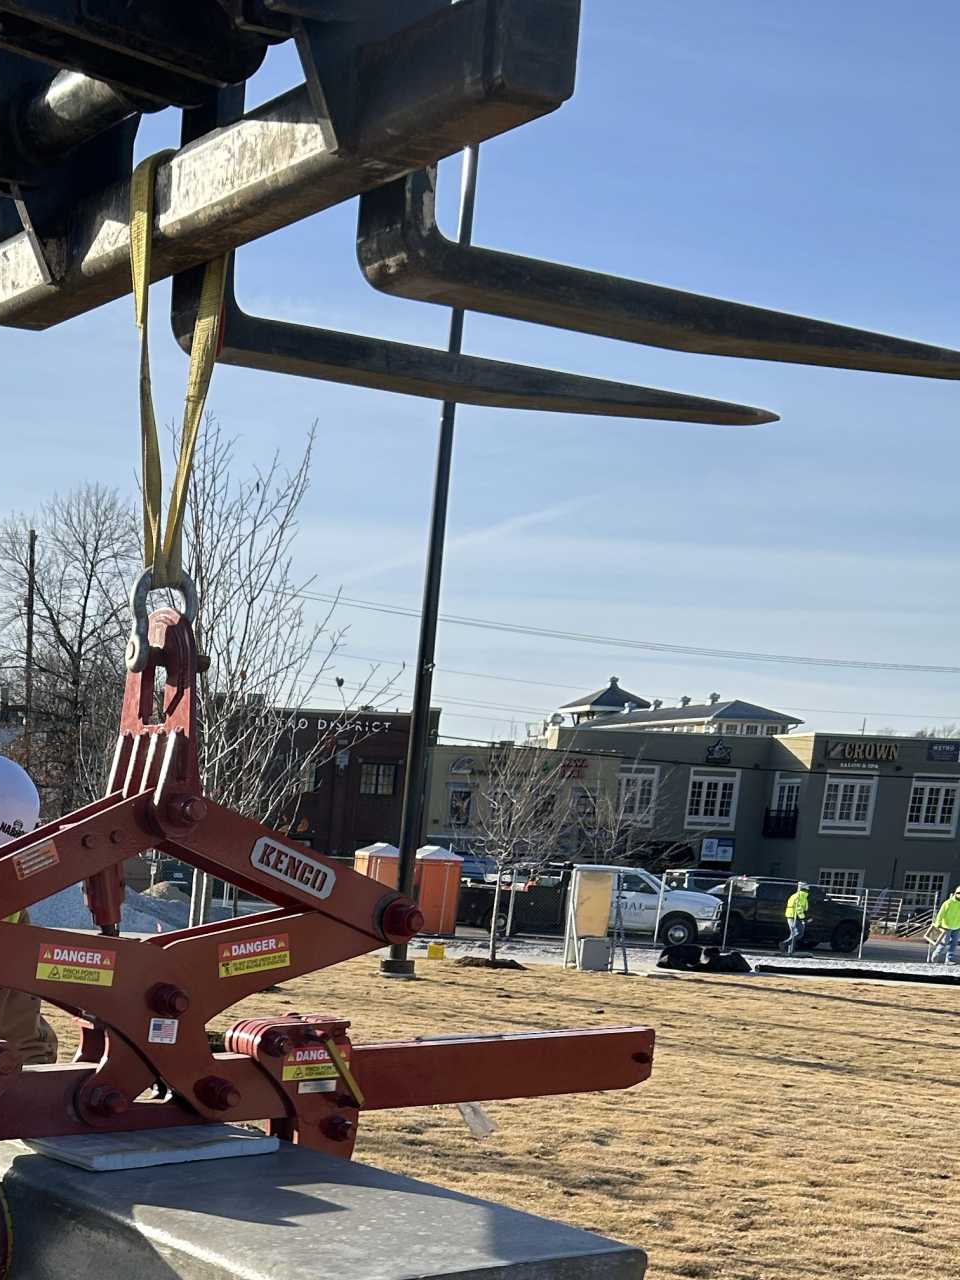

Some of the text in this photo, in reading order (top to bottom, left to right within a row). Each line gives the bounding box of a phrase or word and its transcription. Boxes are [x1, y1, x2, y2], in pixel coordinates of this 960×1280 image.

[845, 742, 898, 761] CROWN
[258, 842, 328, 893] KENCO
[53, 948, 102, 964] DANGER
[231, 938, 277, 956] DANGER
[296, 1049, 331, 1061] DANGE
